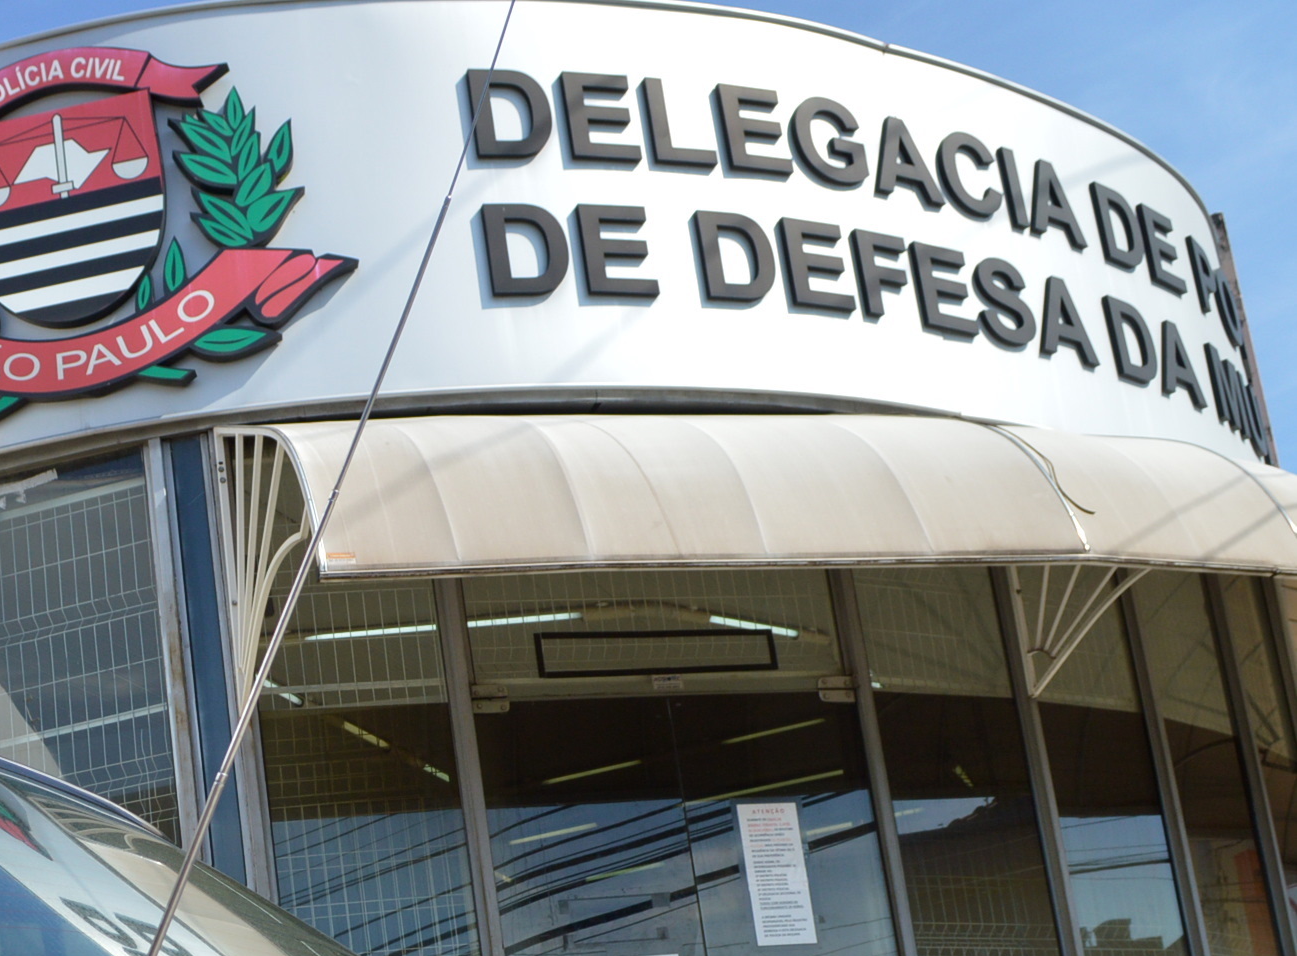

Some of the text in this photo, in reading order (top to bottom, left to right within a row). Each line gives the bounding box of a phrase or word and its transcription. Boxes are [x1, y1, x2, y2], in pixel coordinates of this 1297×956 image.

[70, 57, 125, 82] CIVIL
[466, 68, 1247, 350] DELEGACIA DE PO
[56, 289, 215, 380] PAULO
[481, 203, 660, 300] DE
[692, 208, 1101, 369] DEFESA
[1101, 294, 1208, 411] DA
